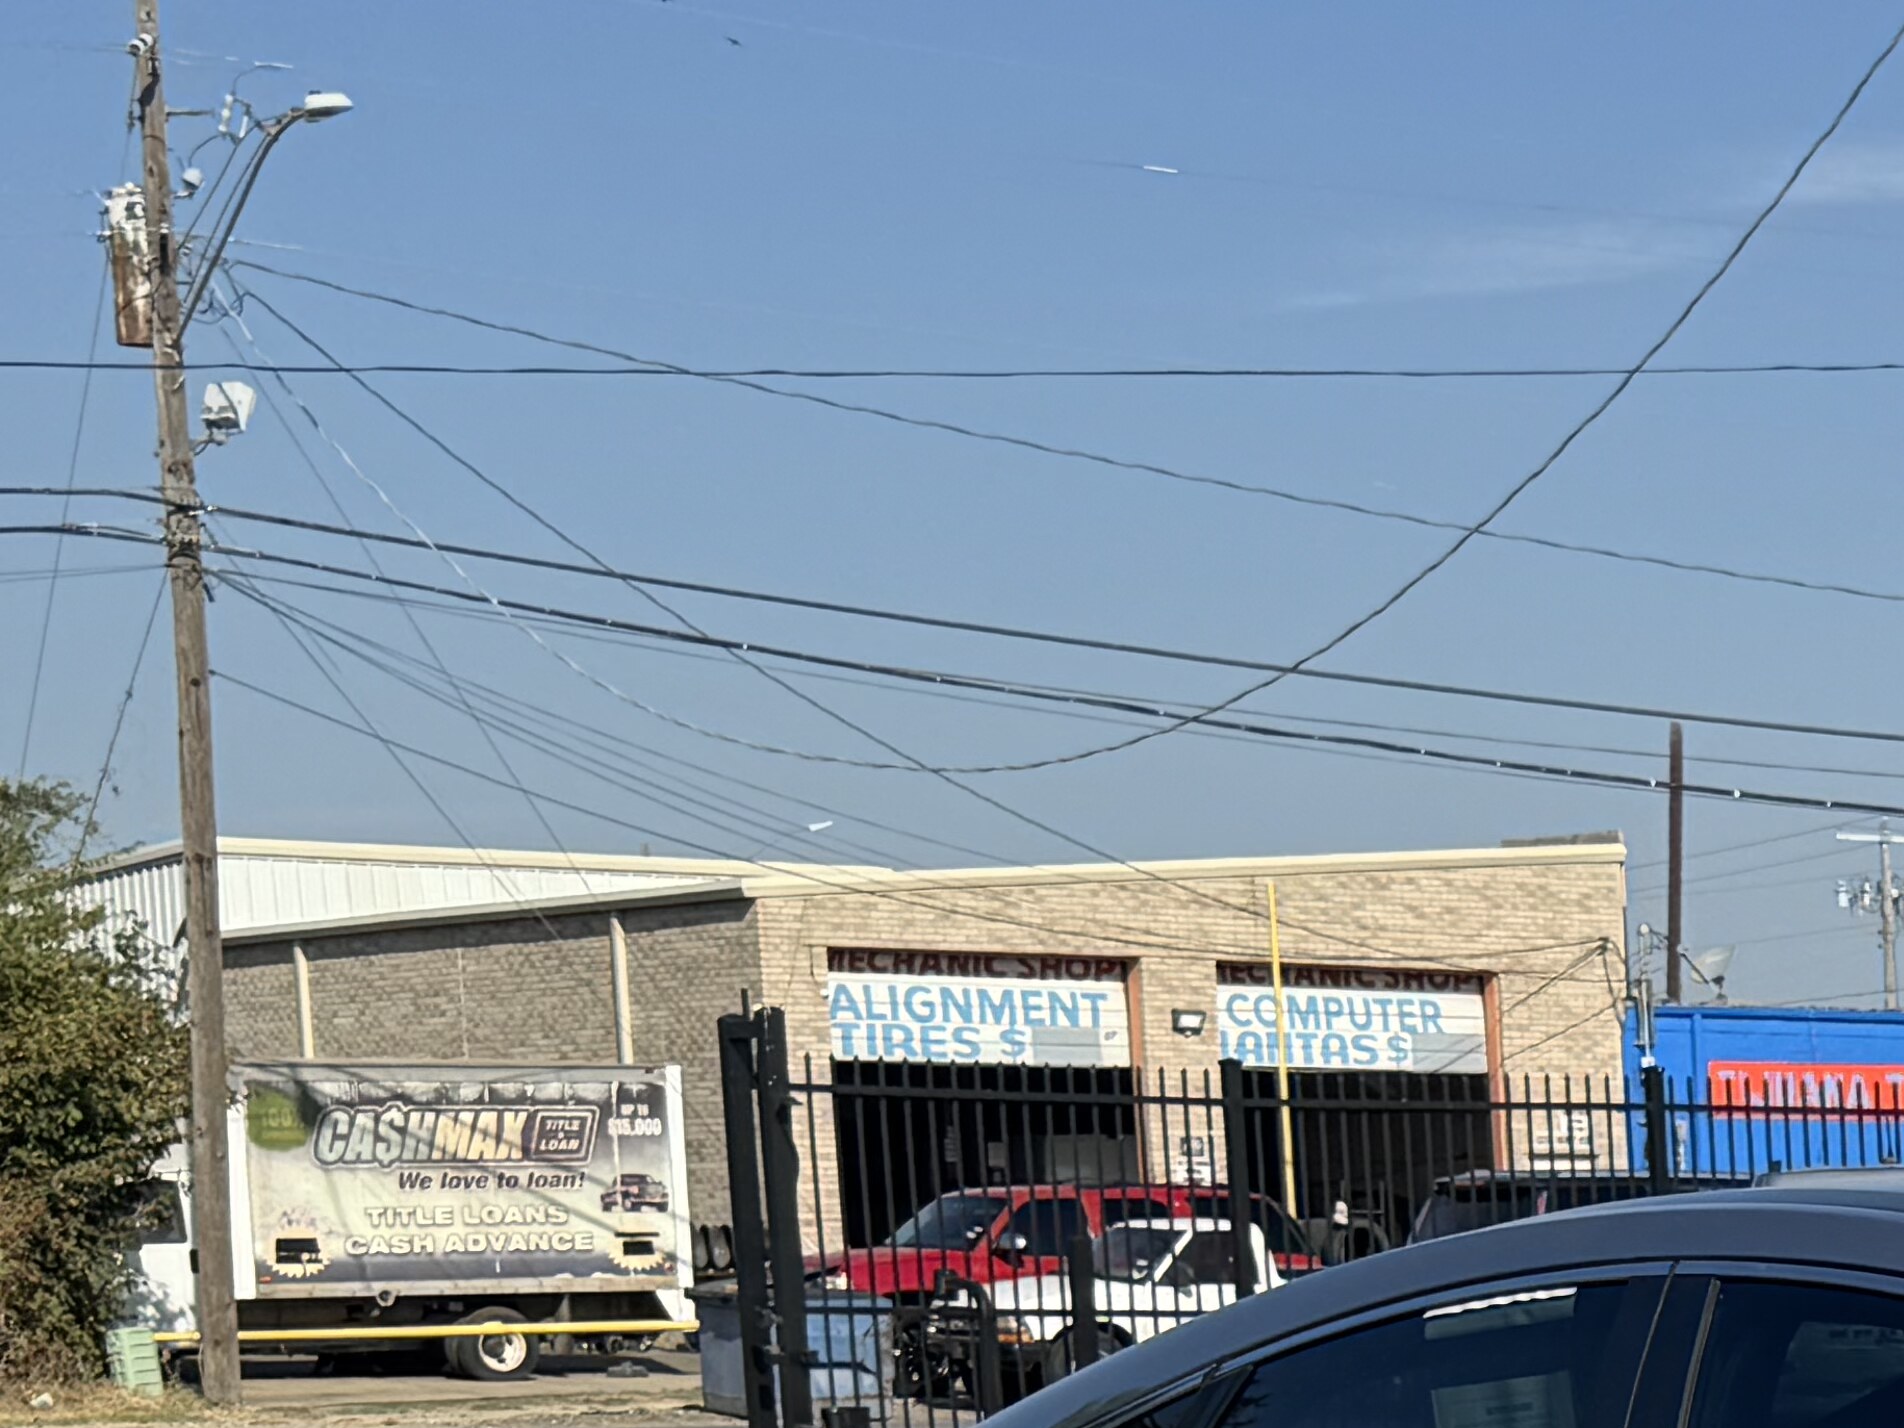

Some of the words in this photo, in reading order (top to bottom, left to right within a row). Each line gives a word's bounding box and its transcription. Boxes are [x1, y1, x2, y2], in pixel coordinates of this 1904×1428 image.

[829, 982, 1109, 1029] ALIGNMENT
[1226, 993, 1446, 1035] COMPUTER
[831, 1022, 981, 1060] TIRES
[545, 1118, 582, 1132] TITLE
[539, 1137, 581, 1151] LOAN
[399, 1171, 432, 1190] We
[440, 1171, 489, 1190] love
[497, 1172, 520, 1189] to
[527, 1170, 586, 1189] loan!
[365, 1206, 454, 1229] TITLE
[462, 1204, 569, 1226] LOANS
[345, 1233, 438, 1257] CASH
[447, 1230, 594, 1254] ADVANCE
